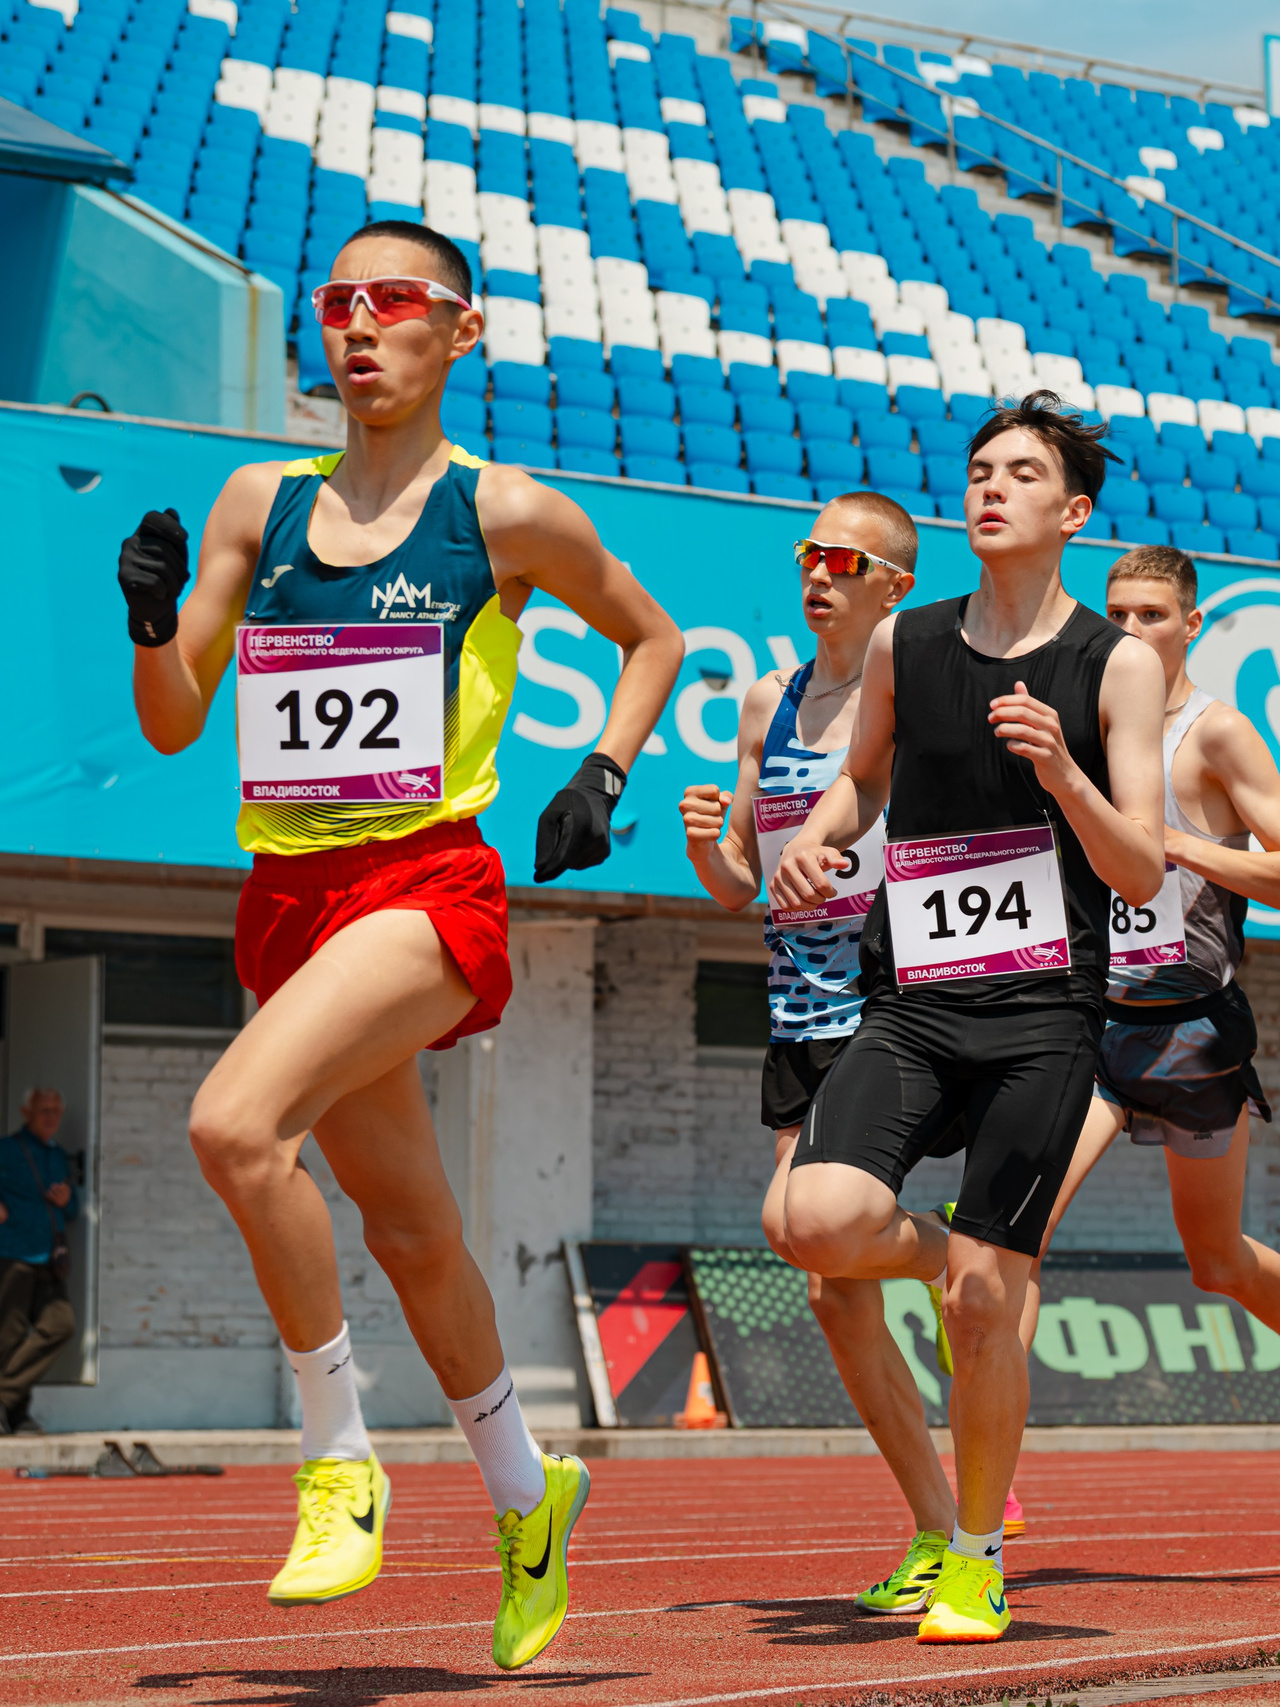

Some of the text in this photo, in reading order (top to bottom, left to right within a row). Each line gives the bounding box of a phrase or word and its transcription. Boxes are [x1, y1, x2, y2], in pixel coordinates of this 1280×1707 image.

[250, 635, 334, 647] ПЕРВЕНСТВО
[250, 646, 424, 657] ДАЛЬНЕВОСТОЧНОГО ФЕДЕРАЛЬНОГО ОКРУГА
[275, 688, 400, 750] 192
[253, 785, 340, 798] ВЛАДИВОСТОК
[760, 799, 808, 813] ПЕРВЕНСТВО
[894, 843, 968, 860] ПЕРВЕНСТВО
[895, 845, 1041, 868] ДАЛЬНЕВОСТОЧНОГО ФЕДЕРАЛЬНОГО ОКРУГА
[778, 907, 829, 922] ВЛАДИВОСТОК
[922, 881, 1031, 939] 194
[1112, 896, 1157, 934] 85
[907, 963, 986, 980] ВЛАДИВОСТОК
